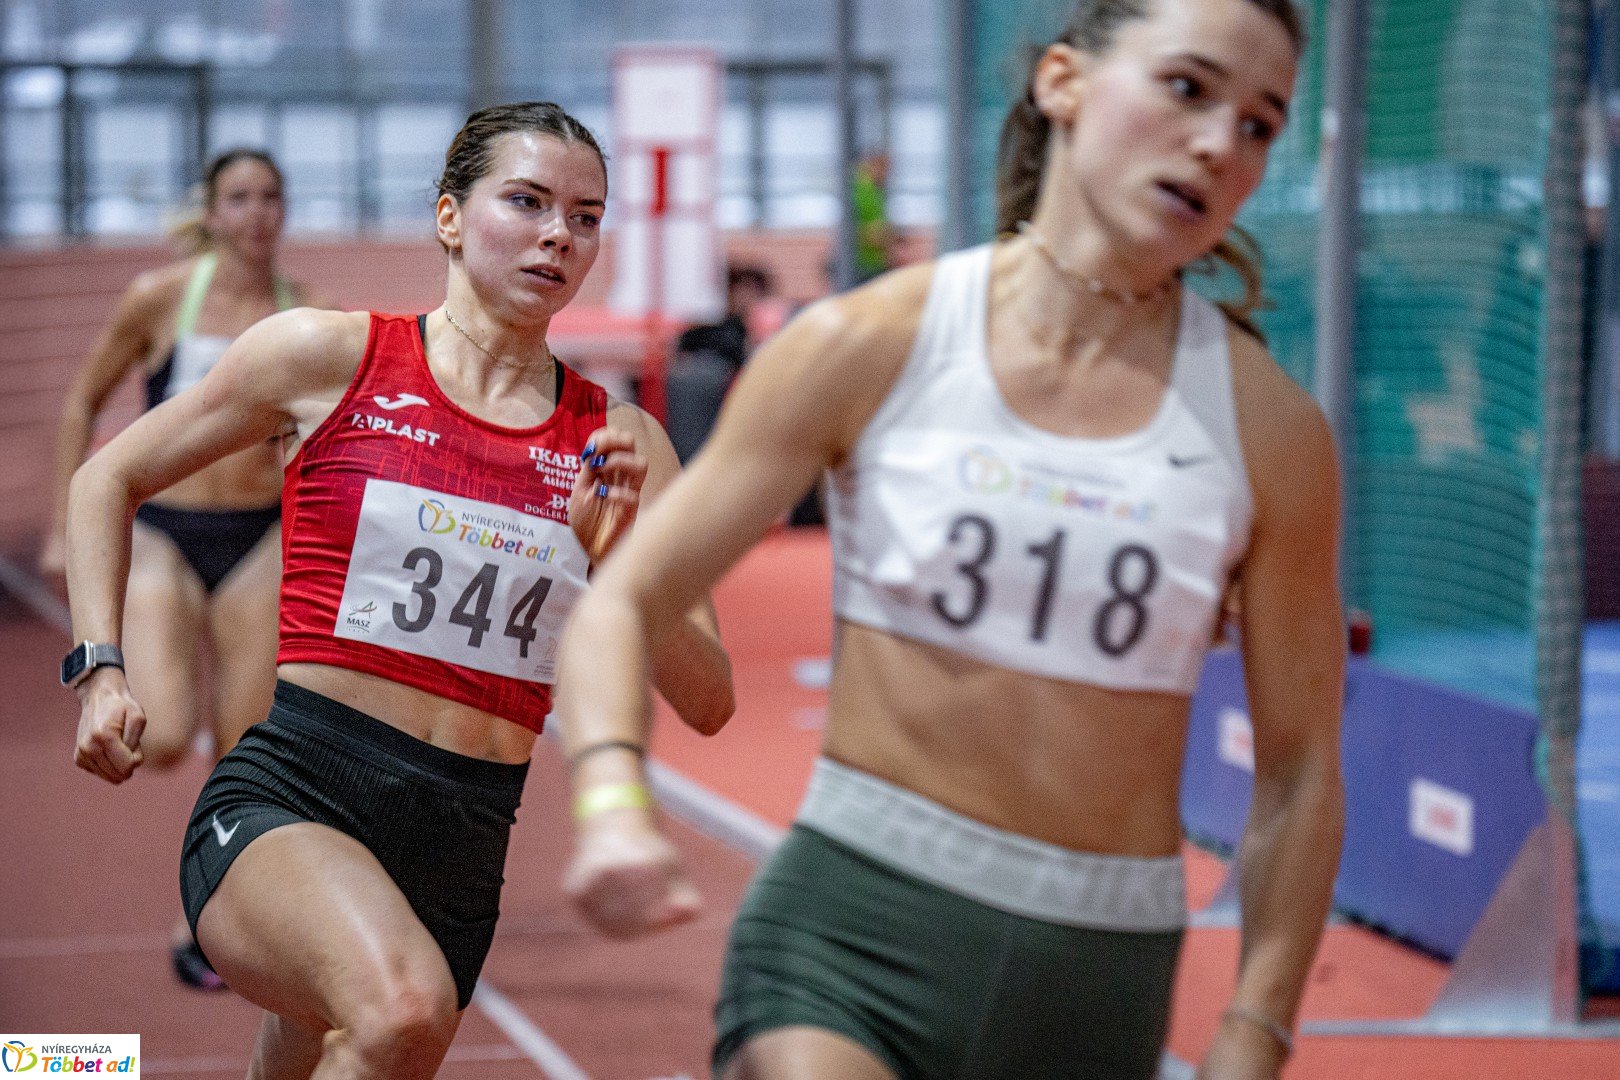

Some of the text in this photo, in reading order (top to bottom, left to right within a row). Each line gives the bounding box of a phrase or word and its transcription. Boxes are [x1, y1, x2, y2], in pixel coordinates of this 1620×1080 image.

[528, 445, 582, 470] IKAR
[461, 512, 535, 538] NYÍREGYHÁZA
[458, 524, 557, 564] Többet ad!
[931, 513, 1160, 657] 318
[391, 546, 553, 659] 344
[346, 617, 371, 629] MASZ
